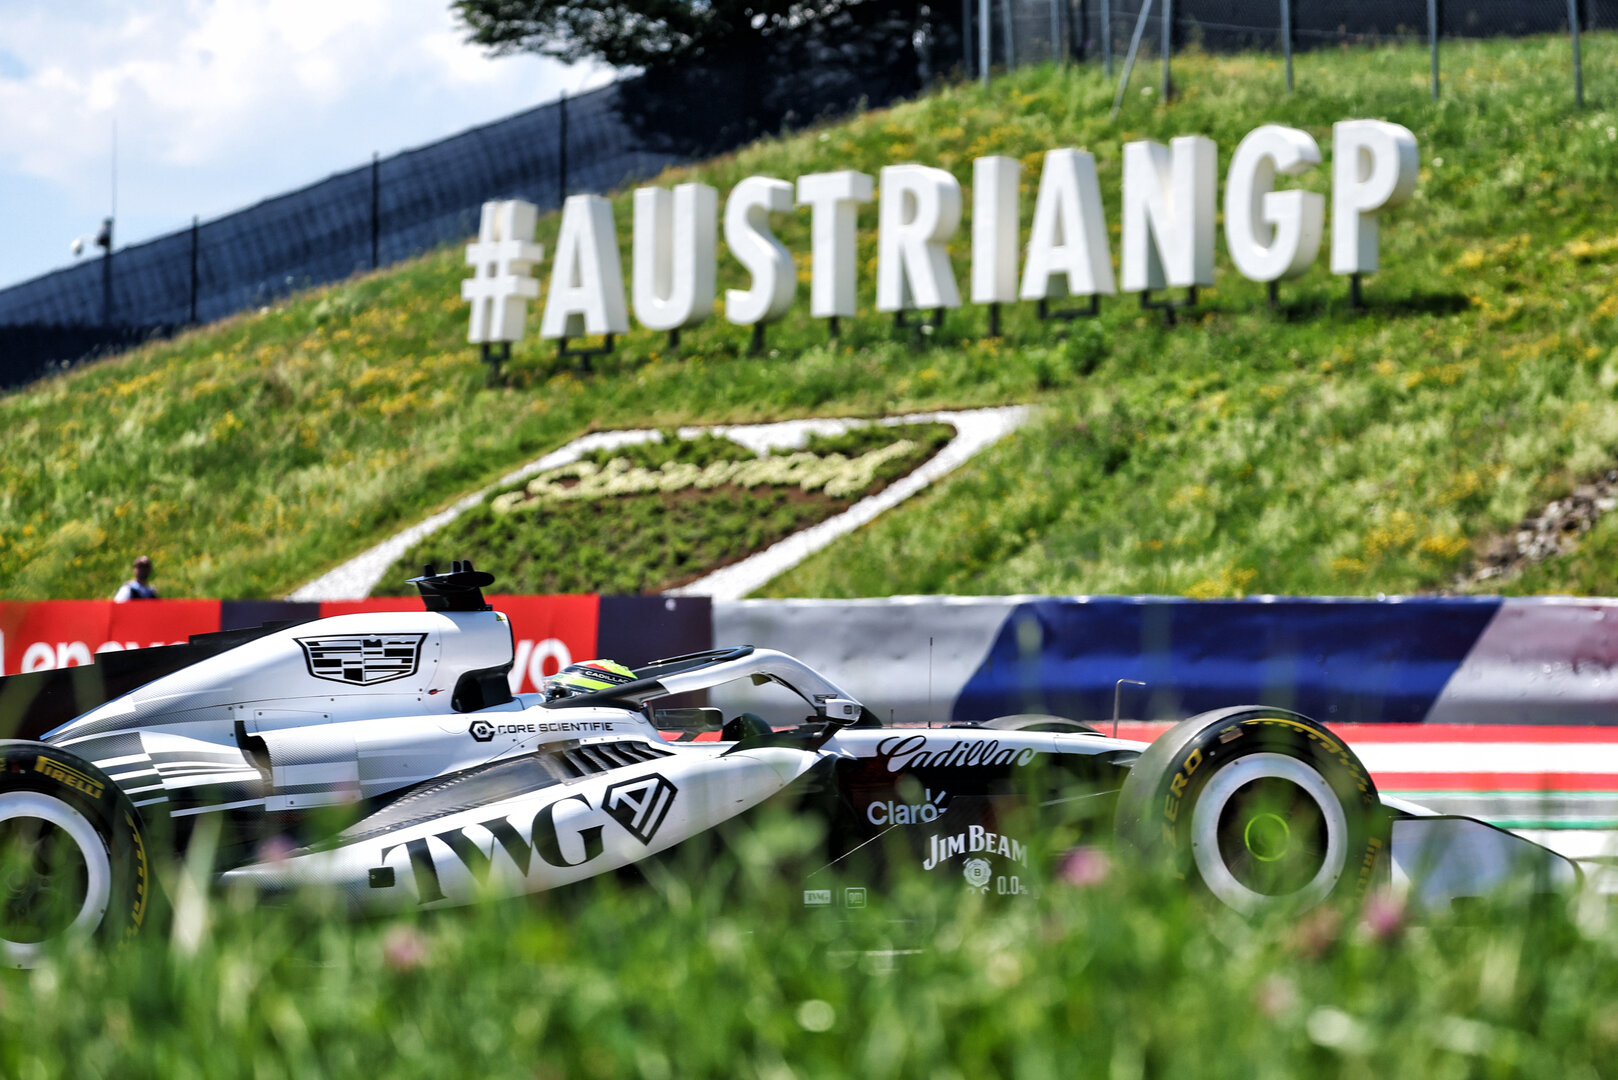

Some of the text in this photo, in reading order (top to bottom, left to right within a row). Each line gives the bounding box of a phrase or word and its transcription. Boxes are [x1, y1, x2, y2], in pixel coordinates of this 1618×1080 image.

[461, 119, 1419, 346] #AUSTRIANGP
[497, 725, 536, 733] CORE
[876, 735, 1035, 773] Cadillac
[34, 755, 105, 799] PIRELLI
[866, 800, 939, 826] Claro
[381, 793, 605, 905] TWG
[922, 824, 1029, 871] JIM BEAM
